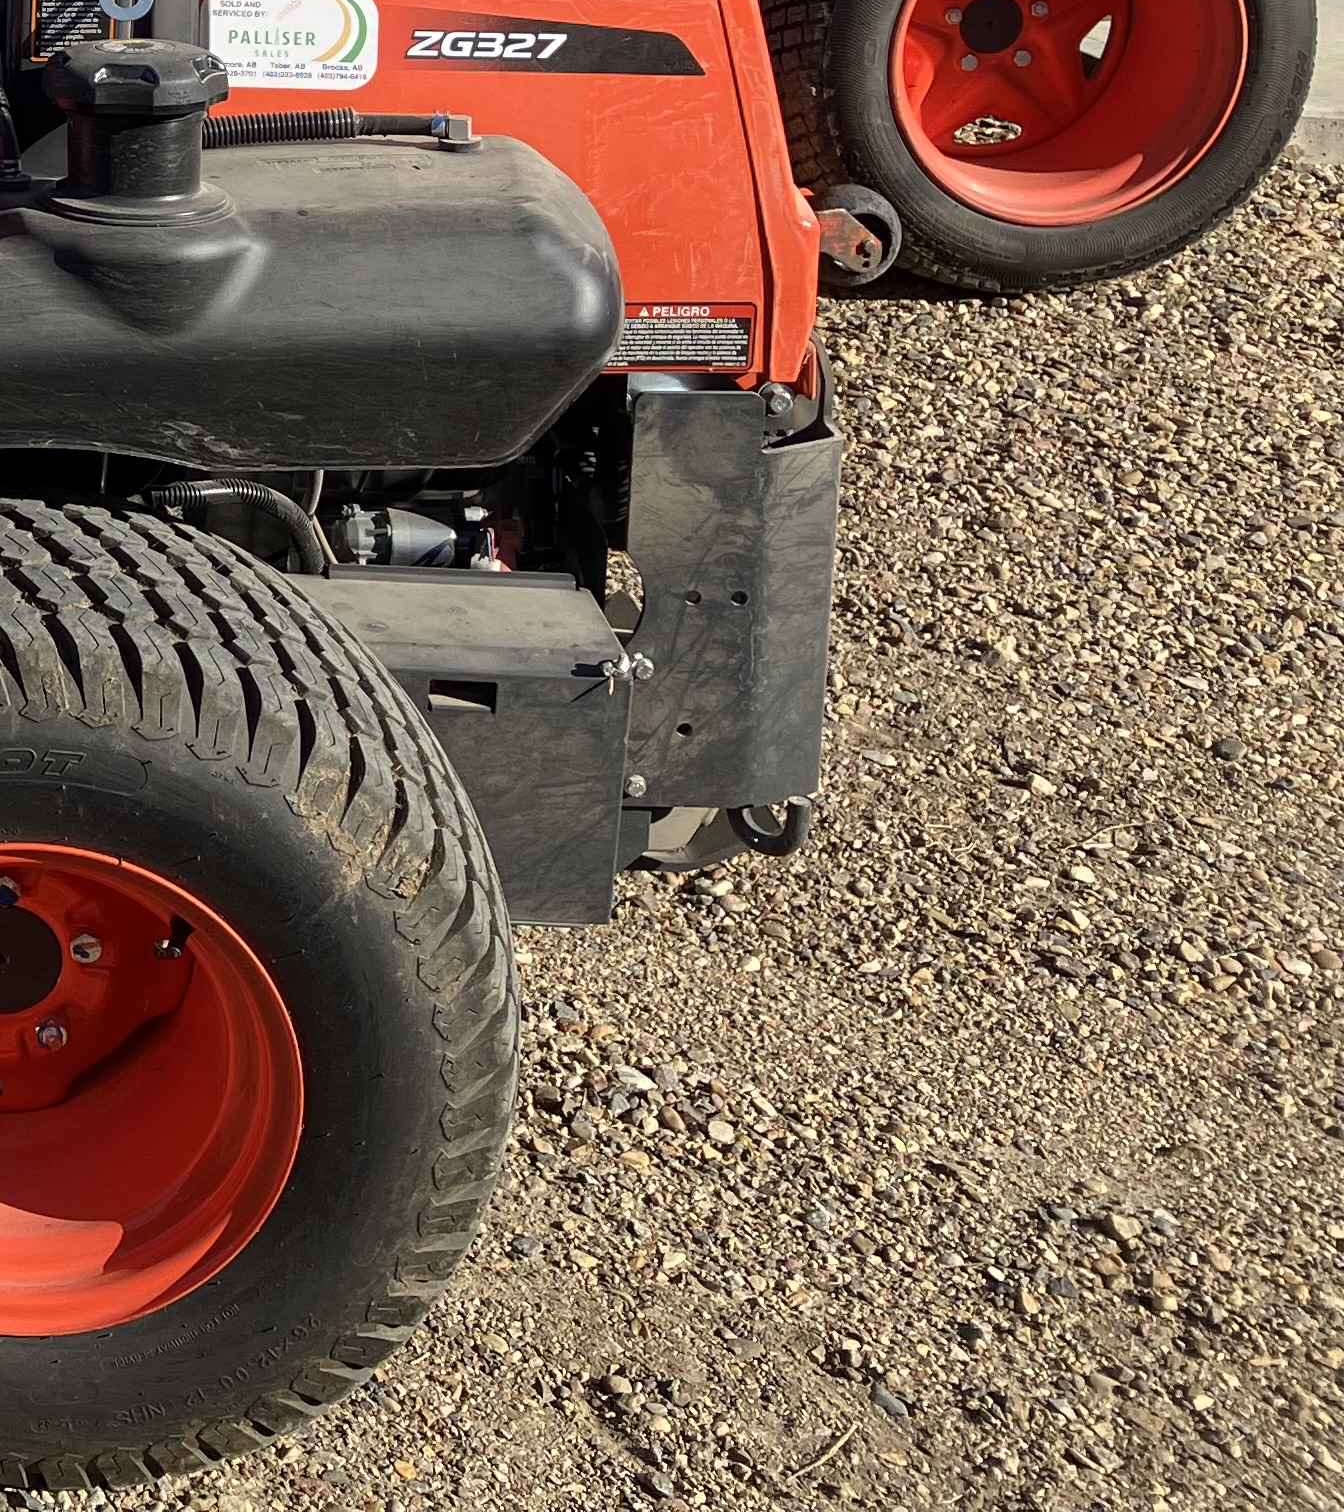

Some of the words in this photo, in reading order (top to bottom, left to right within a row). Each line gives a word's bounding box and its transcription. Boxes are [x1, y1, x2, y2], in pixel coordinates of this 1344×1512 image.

[220, 0, 242, 8] SOLD
[228, 26, 316, 46] PALLISER
[405, 29, 568, 60] ZG327
[254, 49, 290, 58] SALES
[652, 306, 711, 318] PELIGRO
